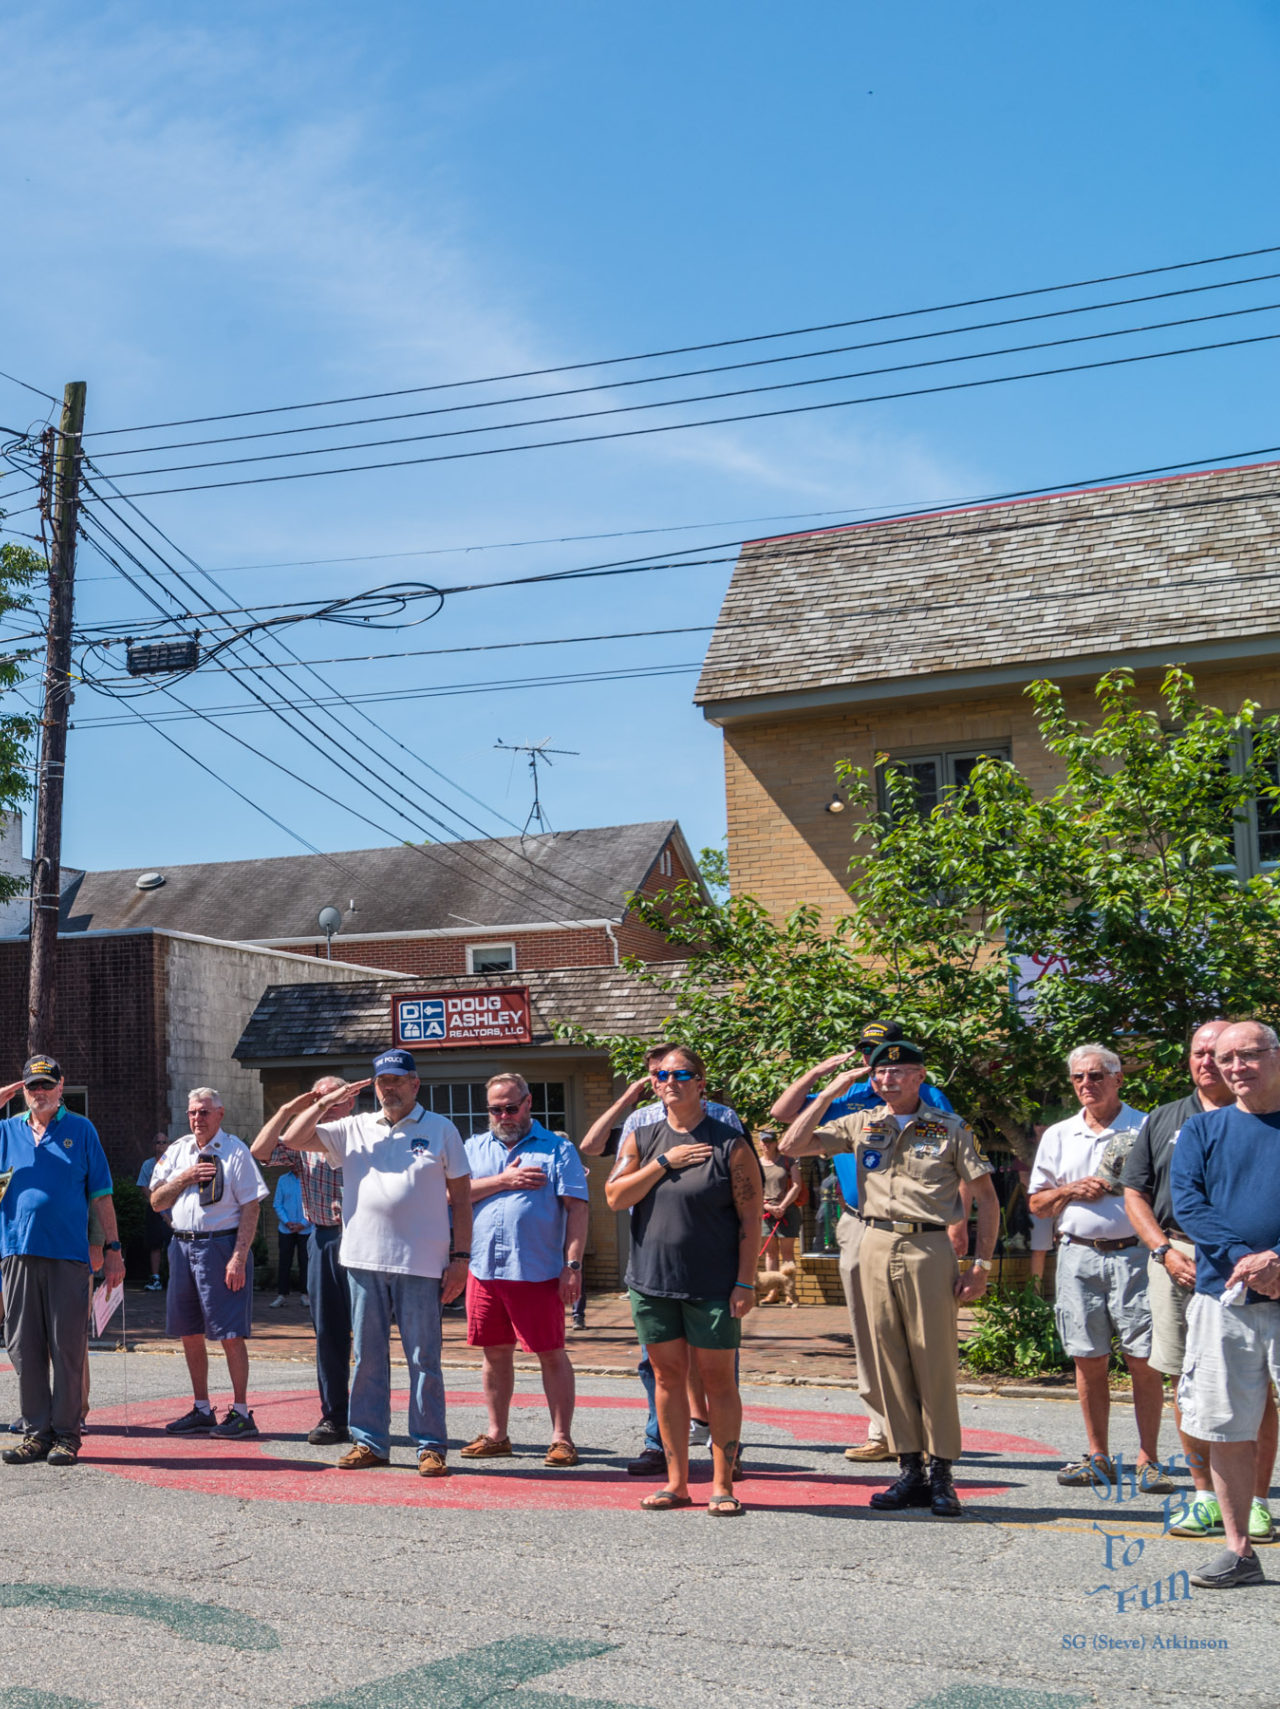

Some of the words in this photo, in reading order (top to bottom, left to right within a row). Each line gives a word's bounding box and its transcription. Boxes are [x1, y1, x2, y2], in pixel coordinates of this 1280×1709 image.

[402, 1005, 420, 1019] D
[448, 996, 501, 1013] DOUG
[449, 1010, 523, 1028] ASHLEY
[425, 1021, 443, 1036] A
[449, 1028, 503, 1038] REALTORS,
[505, 1026, 524, 1035] LLC
